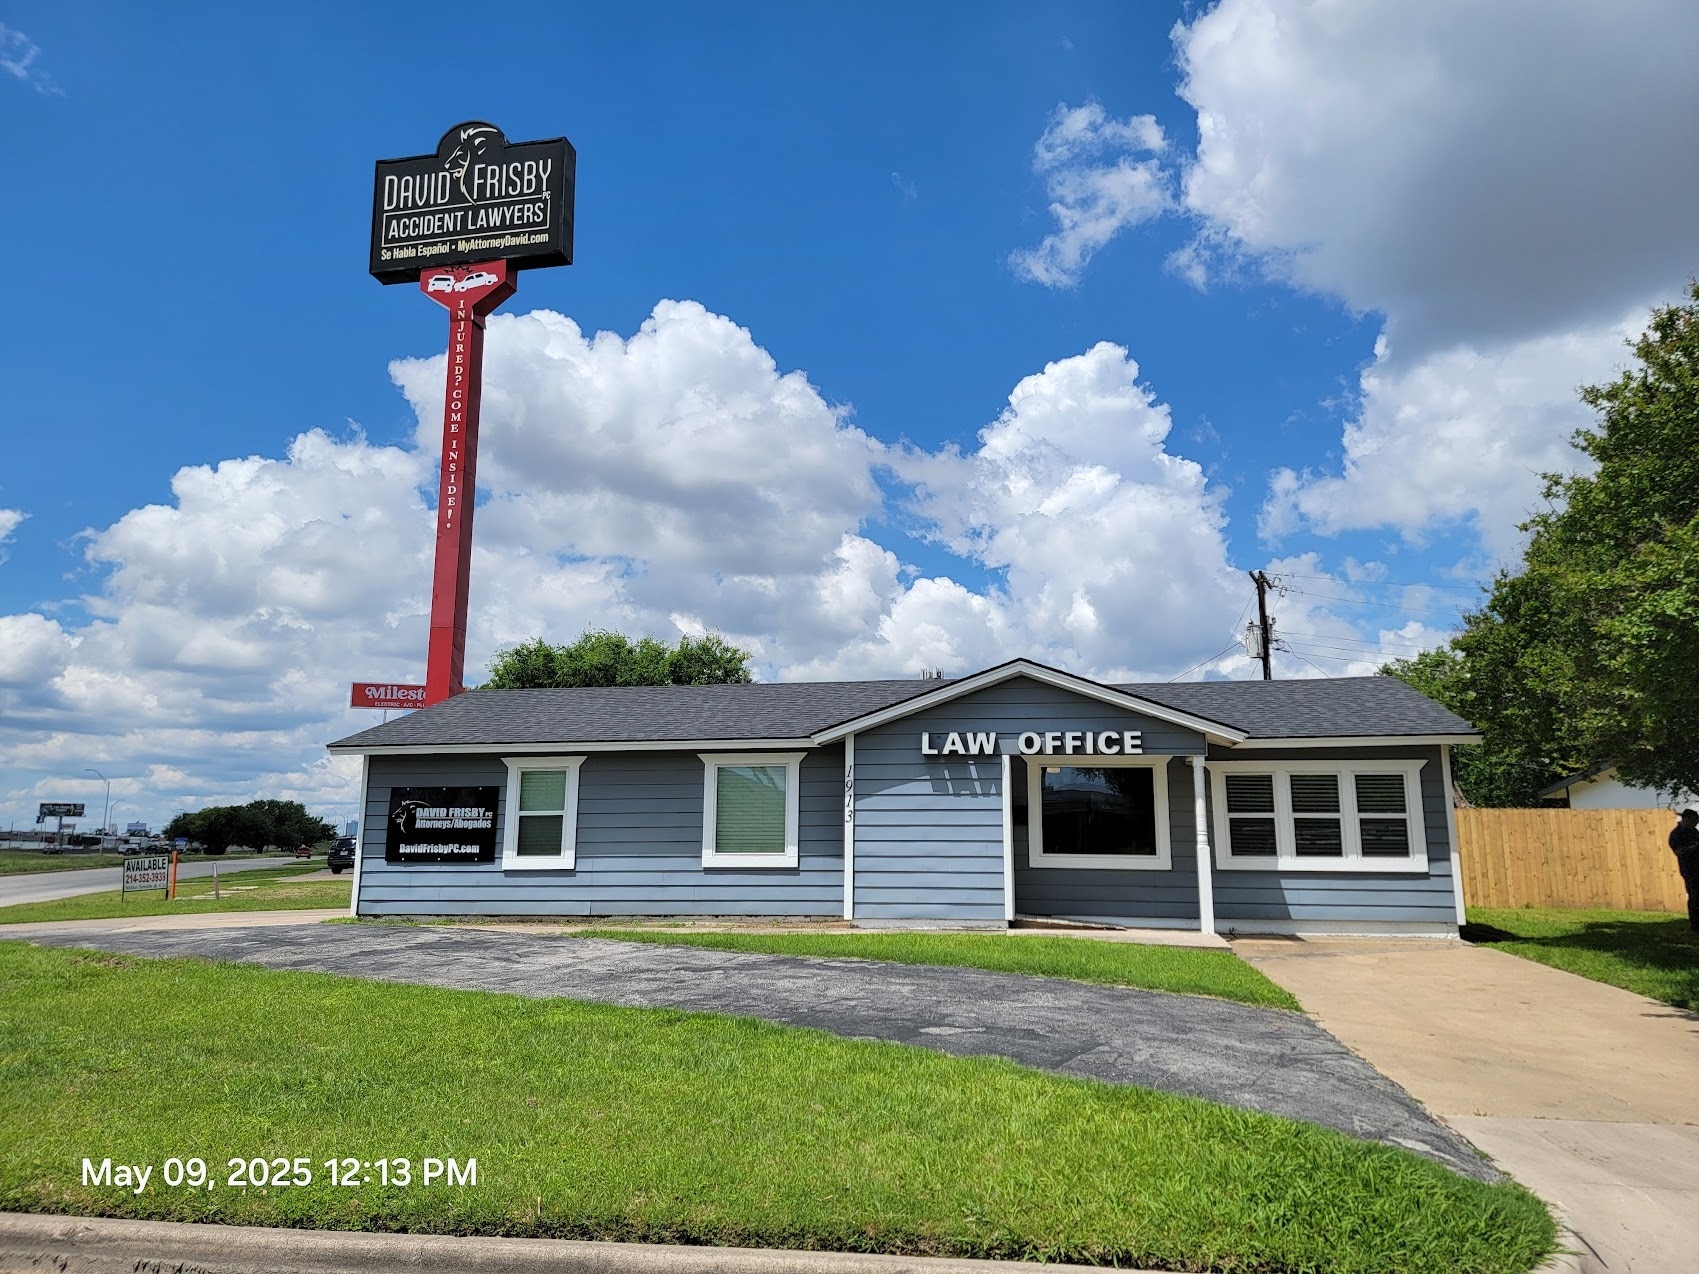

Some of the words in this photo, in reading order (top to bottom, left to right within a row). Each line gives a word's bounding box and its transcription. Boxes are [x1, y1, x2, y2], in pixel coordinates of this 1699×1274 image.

[383, 171, 450, 211] DAVID
[473, 158, 552, 200] FRISBY
[541, 191, 551, 200] PC
[388, 211, 465, 239] ACCIDENT
[468, 203, 544, 230] LAWYERS
[381, 248, 392, 261] Se
[393, 246, 416, 260] Habla
[417, 241, 450, 258] Español
[457, 232, 549, 253] MyAttorneyDavid.com
[454, 299, 466, 387] INJURED?
[450, 389, 462, 433] COME
[446, 440, 459, 529] INSIDE!
[365, 685, 427, 701] Milest
[920, 731, 998, 756] LAW
[1016, 730, 1144, 756] OFFICE
[845, 765, 853, 823] 1913
[415, 807, 448, 818] DAVID
[448, 807, 486, 818] FRISBY
[415, 819, 492, 830] Attorneys/Abogados
[399, 843, 480, 855] DavidFrisbyPC.com
[125, 872, 166, 884] 214-352-3939
[126, 858, 167, 872] AVAILABLE
